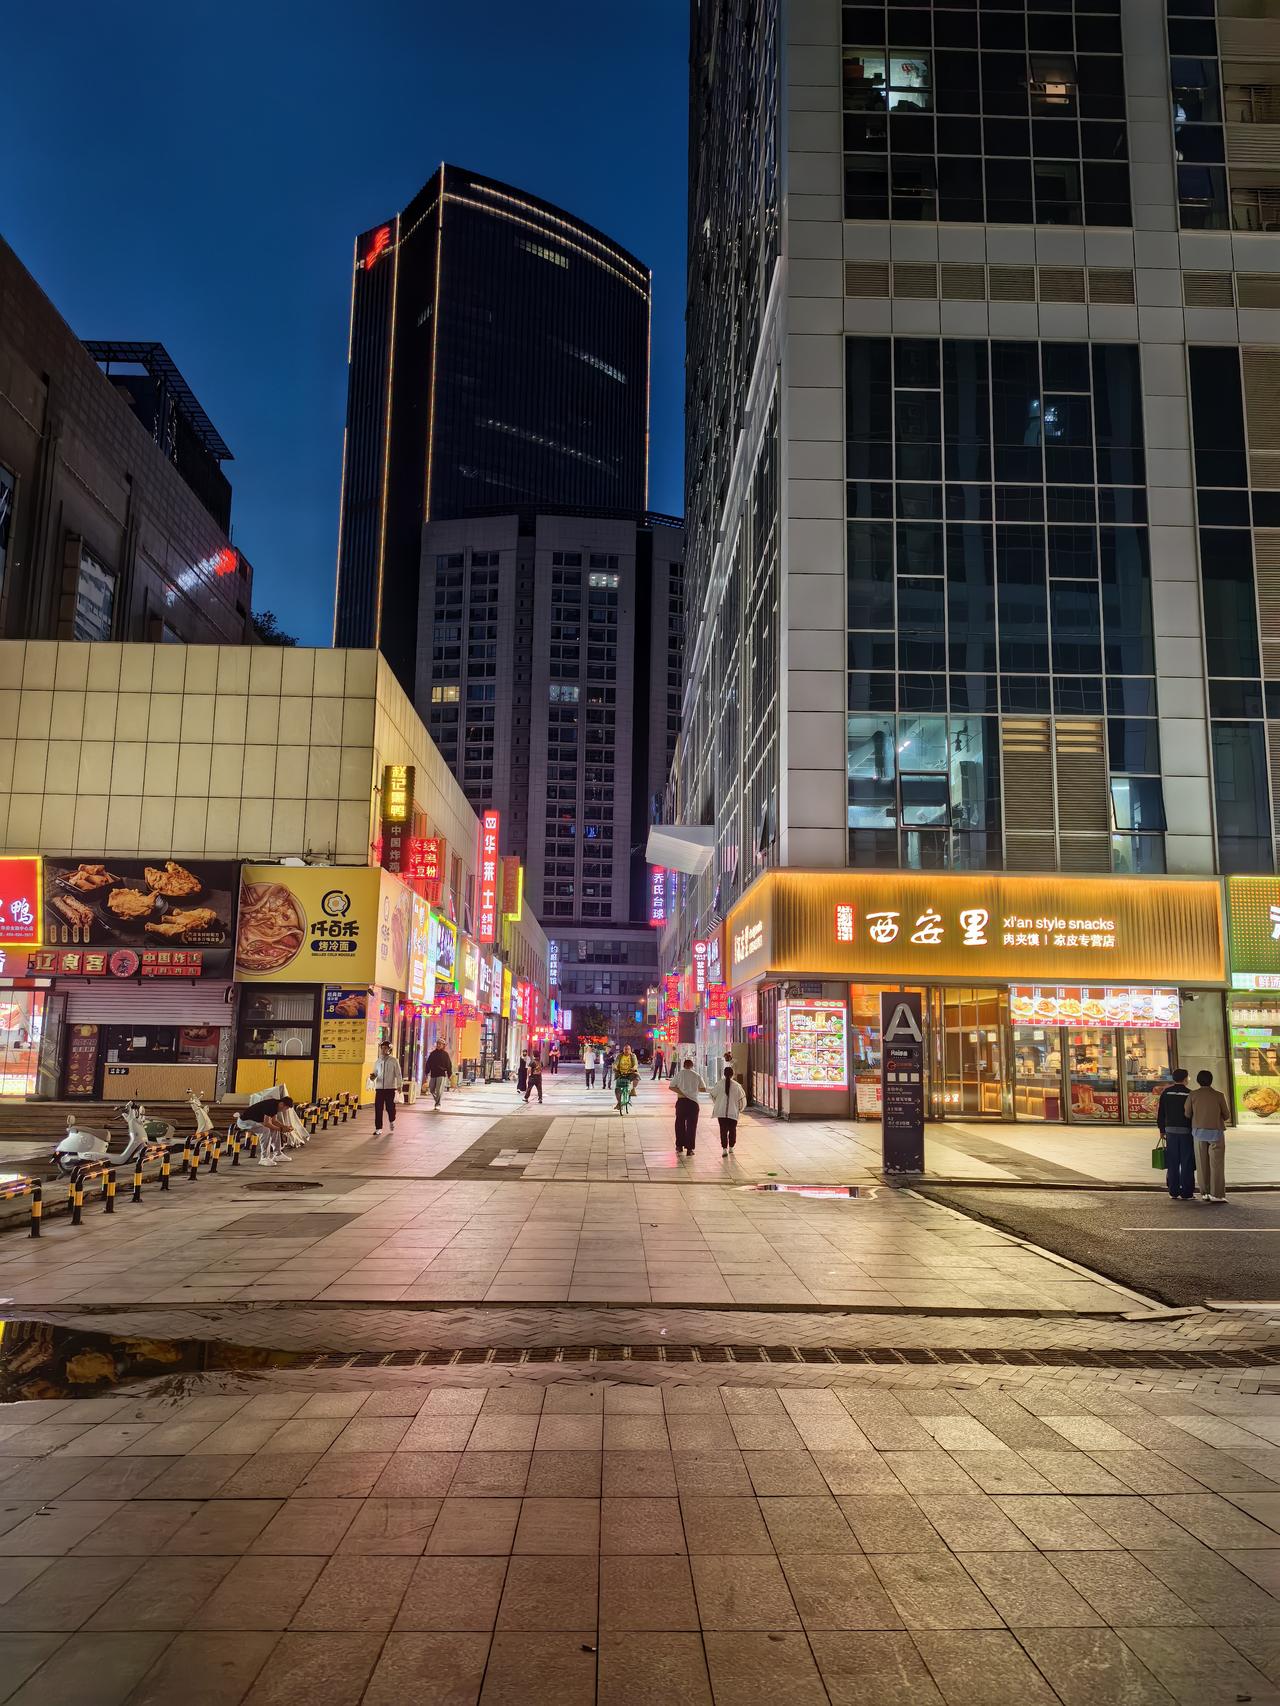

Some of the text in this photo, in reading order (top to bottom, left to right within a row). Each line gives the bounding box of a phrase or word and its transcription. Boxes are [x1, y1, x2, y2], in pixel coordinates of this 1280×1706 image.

[483, 835, 496, 909] 华莱士
[653, 873, 664, 919] 乔氏台球
[1036, 917, 1066, 931] style
[1069, 918, 1115, 930] snacks
[318, 941, 350, 951] 烤冷面
[1054, 934, 1116, 947] 凉皮专营店
[884, 1003, 923, 1042] A
